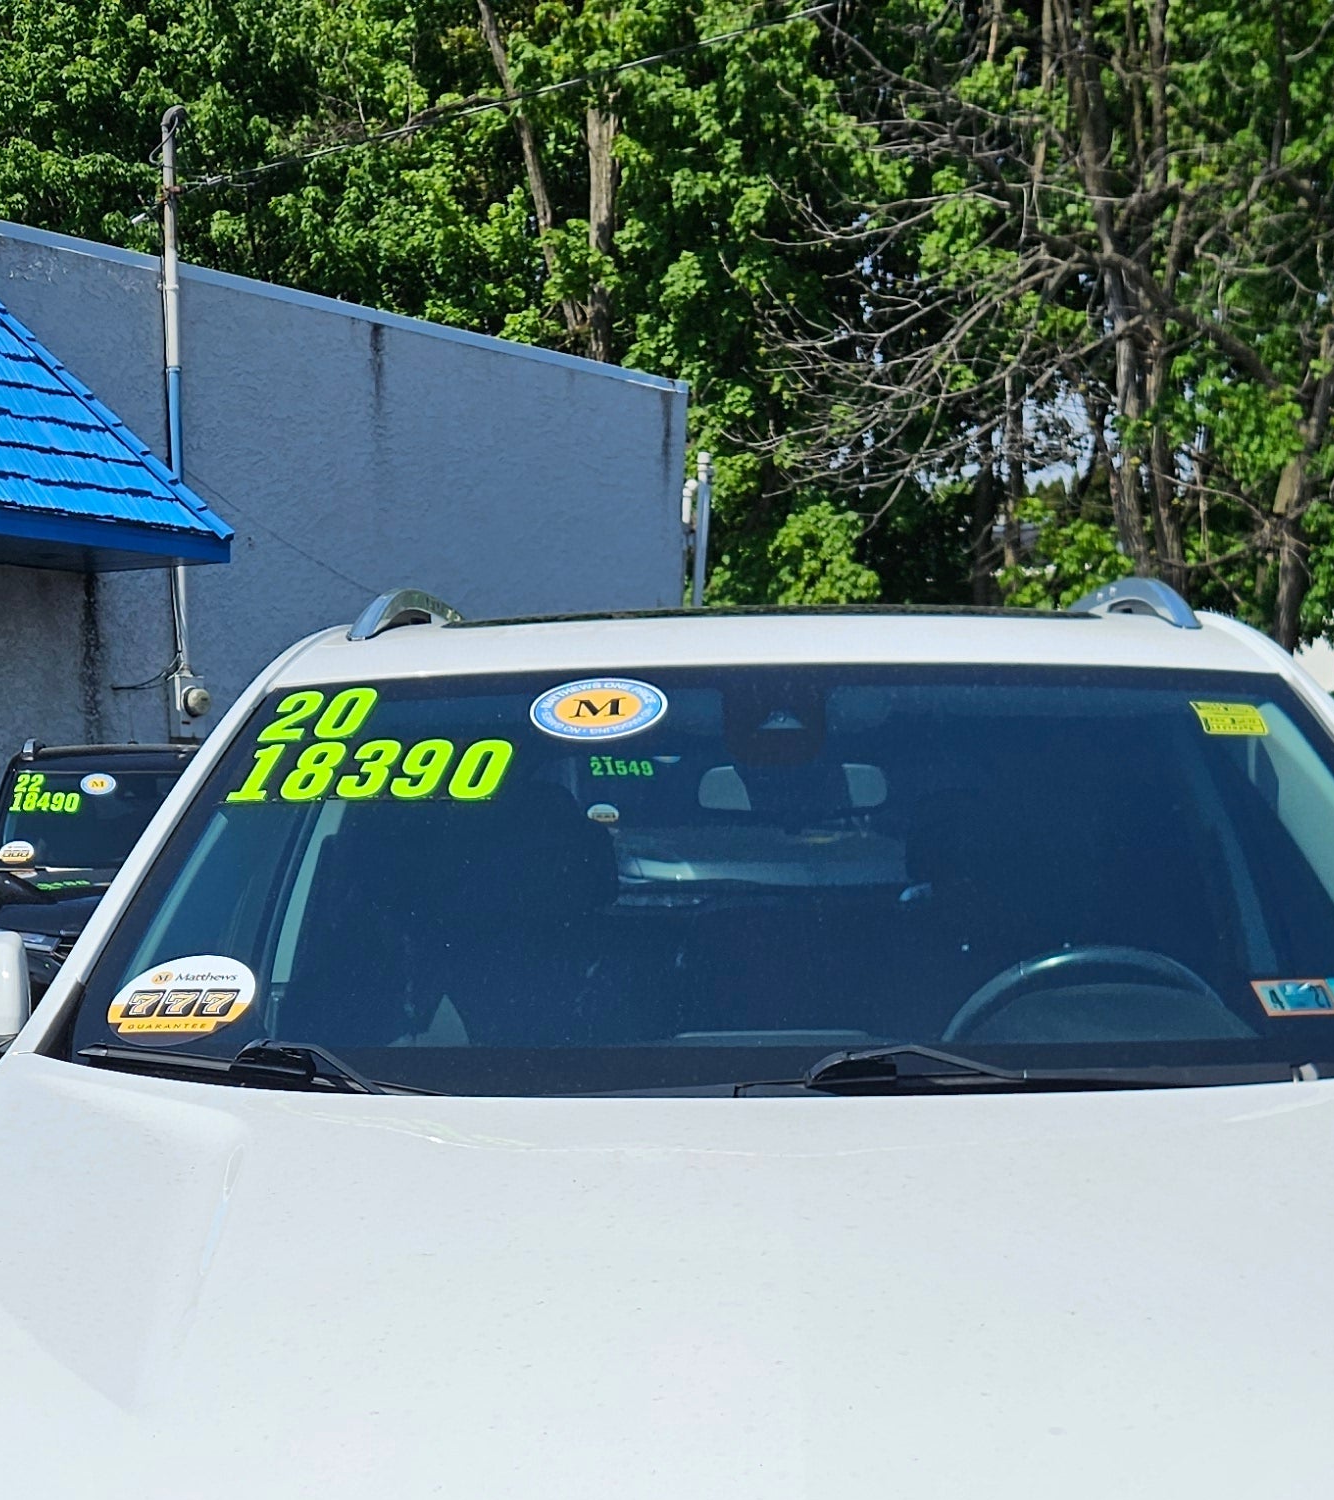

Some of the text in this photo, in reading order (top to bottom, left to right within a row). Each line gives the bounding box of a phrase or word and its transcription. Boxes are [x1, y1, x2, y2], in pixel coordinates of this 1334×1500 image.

[257, 687, 378, 743] 20
[569, 697, 627, 718] M
[226, 739, 513, 801] 18390
[590, 758, 654, 776] 21549
[14, 774, 45, 793] 22
[9, 792, 81, 812] 18490
[154, 971, 239, 983] M Matthews
[127, 1022, 207, 1030] GUARANTEE
